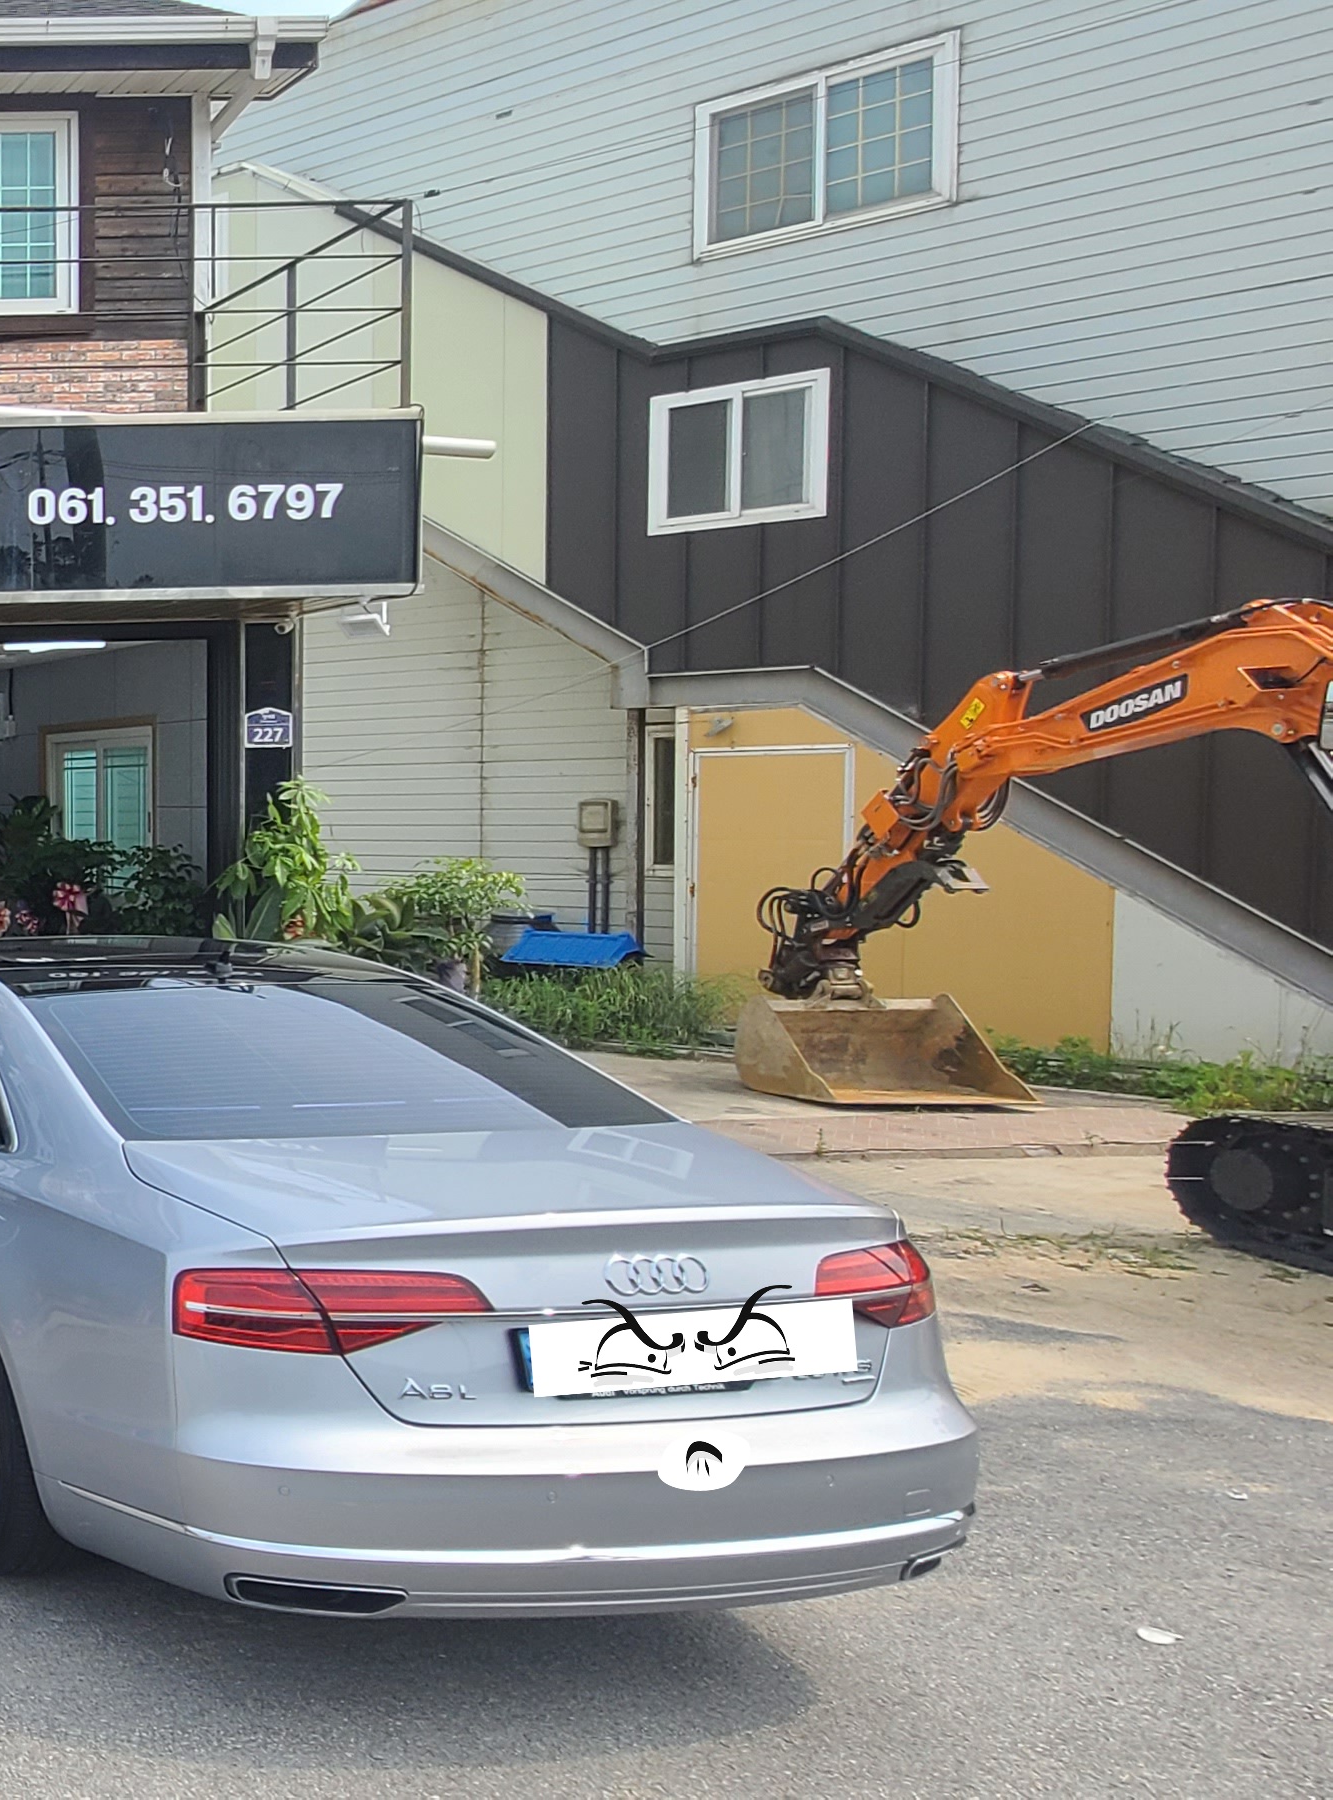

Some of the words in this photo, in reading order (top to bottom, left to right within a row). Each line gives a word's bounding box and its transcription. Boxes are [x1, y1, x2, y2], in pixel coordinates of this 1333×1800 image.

[28, 487, 115, 525] 061.
[129, 485, 215, 523] 351.
[228, 483, 343, 520] 6797
[1090, 681, 1182, 729] DOOSAN
[252, 728, 283, 743] 227
[623, 1386, 666, 1395] Vorsprung
[667, 1384, 692, 1393] durch
[694, 1382, 726, 1391] Technik
